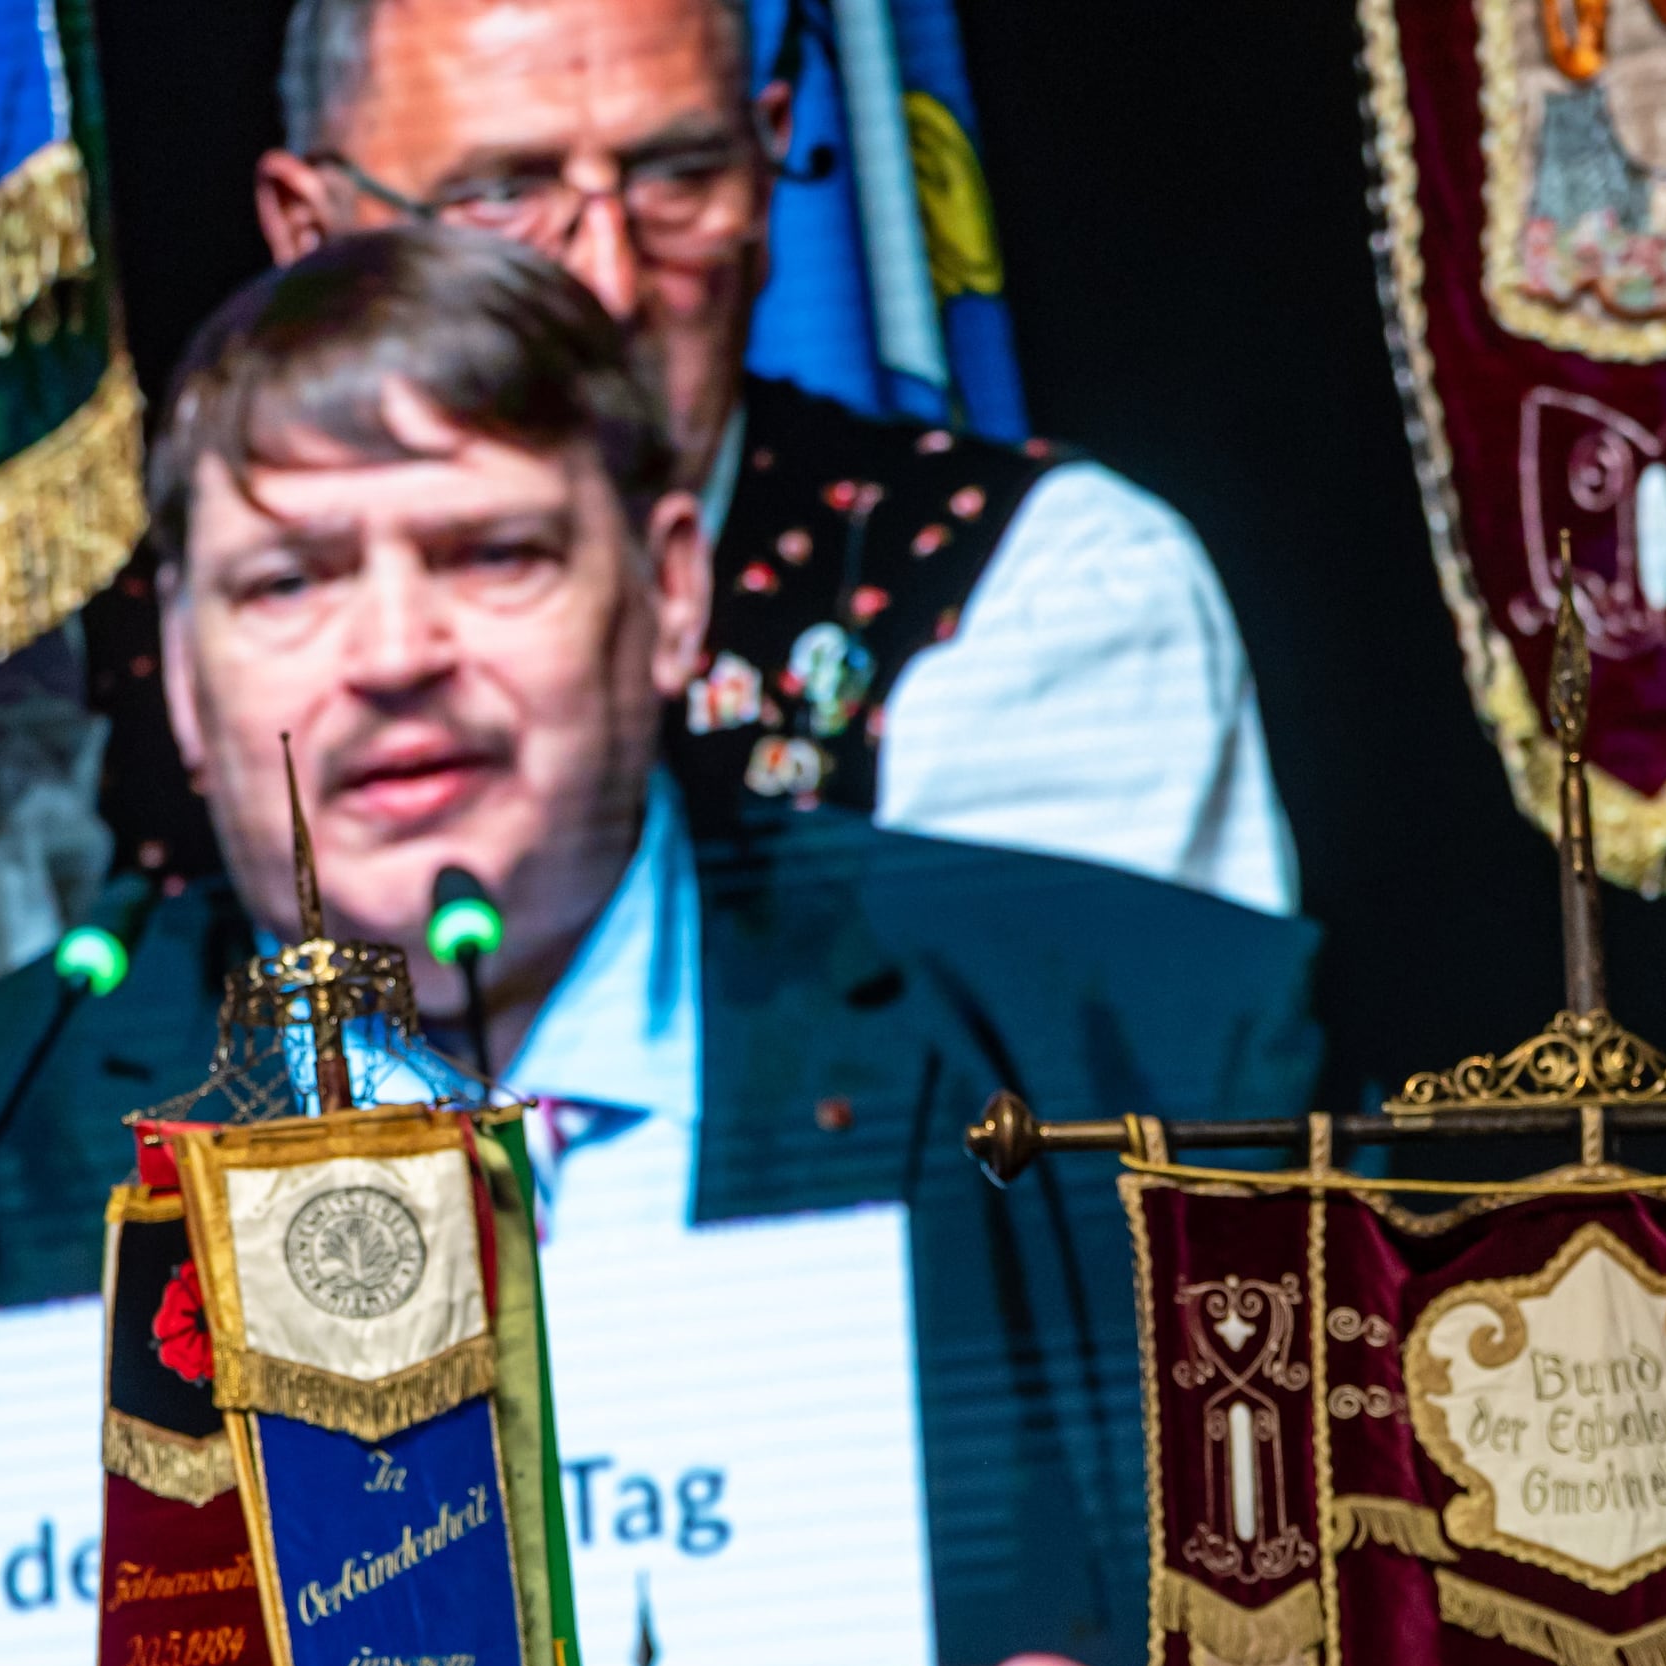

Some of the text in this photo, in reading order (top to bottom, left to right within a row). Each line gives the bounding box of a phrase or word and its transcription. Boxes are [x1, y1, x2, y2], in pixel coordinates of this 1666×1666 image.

[1530, 1342, 1663, 1401] Bund
[1467, 1396, 1529, 1454] der
[563, 1453, 733, 1557] Tag
